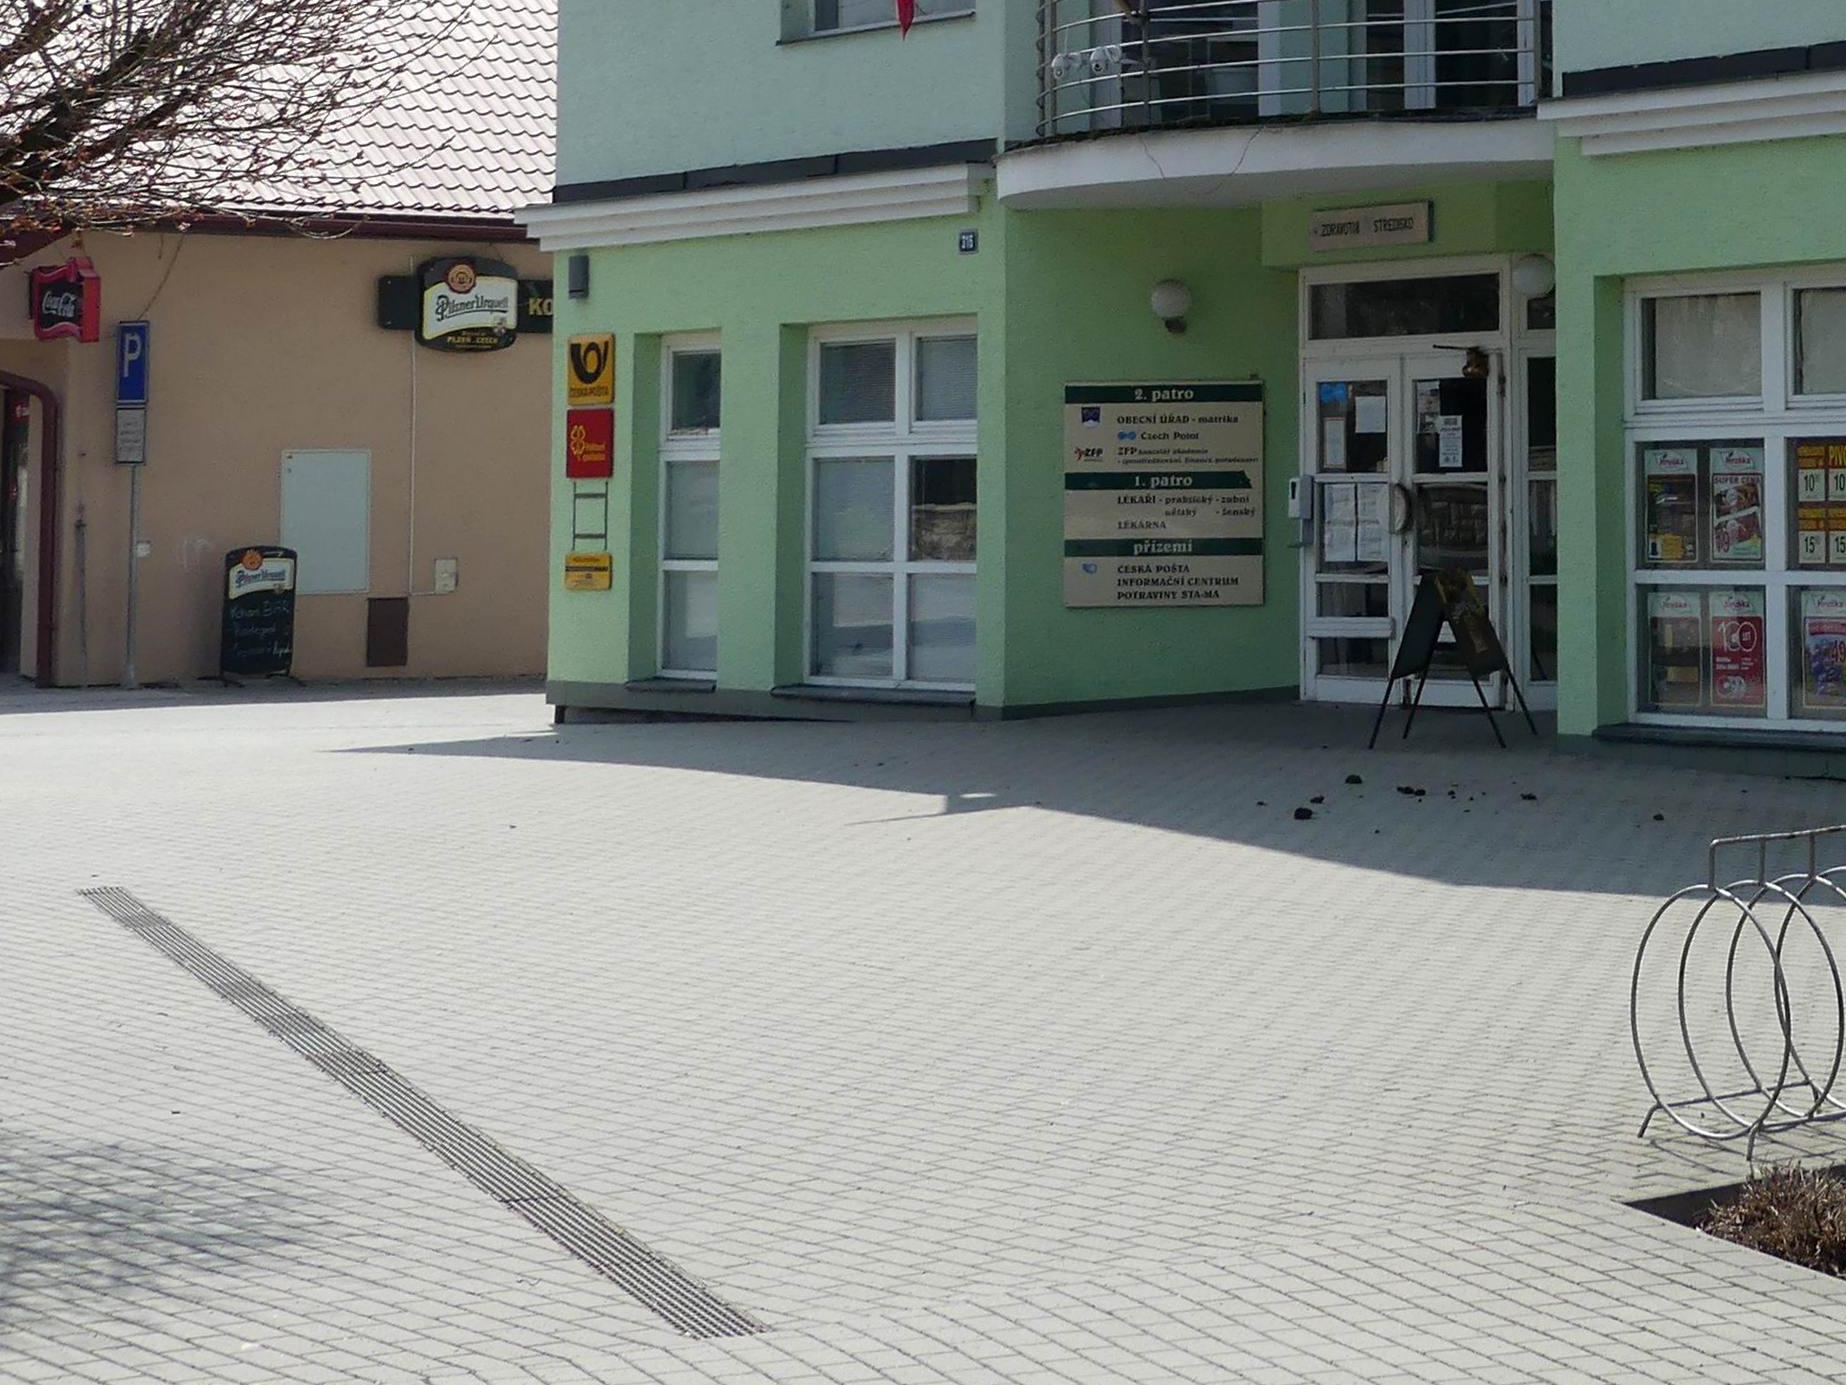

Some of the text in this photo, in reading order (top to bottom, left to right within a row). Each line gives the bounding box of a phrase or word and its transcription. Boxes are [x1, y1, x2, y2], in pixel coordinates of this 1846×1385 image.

[435, 295, 476, 322] Pilsner
[123, 333, 141, 377] P
[1135, 388, 1194, 402] 2. patro
[1140, 431, 1200, 441] Czech Point
[1135, 476, 1192, 489] 1. patro
[1133, 538, 1193, 555] přízemí
[1155, 562, 1190, 573] POŠTA
[1116, 575, 1239, 587] INFORMAČNÍ CENTRUM
[1116, 590, 1178, 600] POTRAVINY
